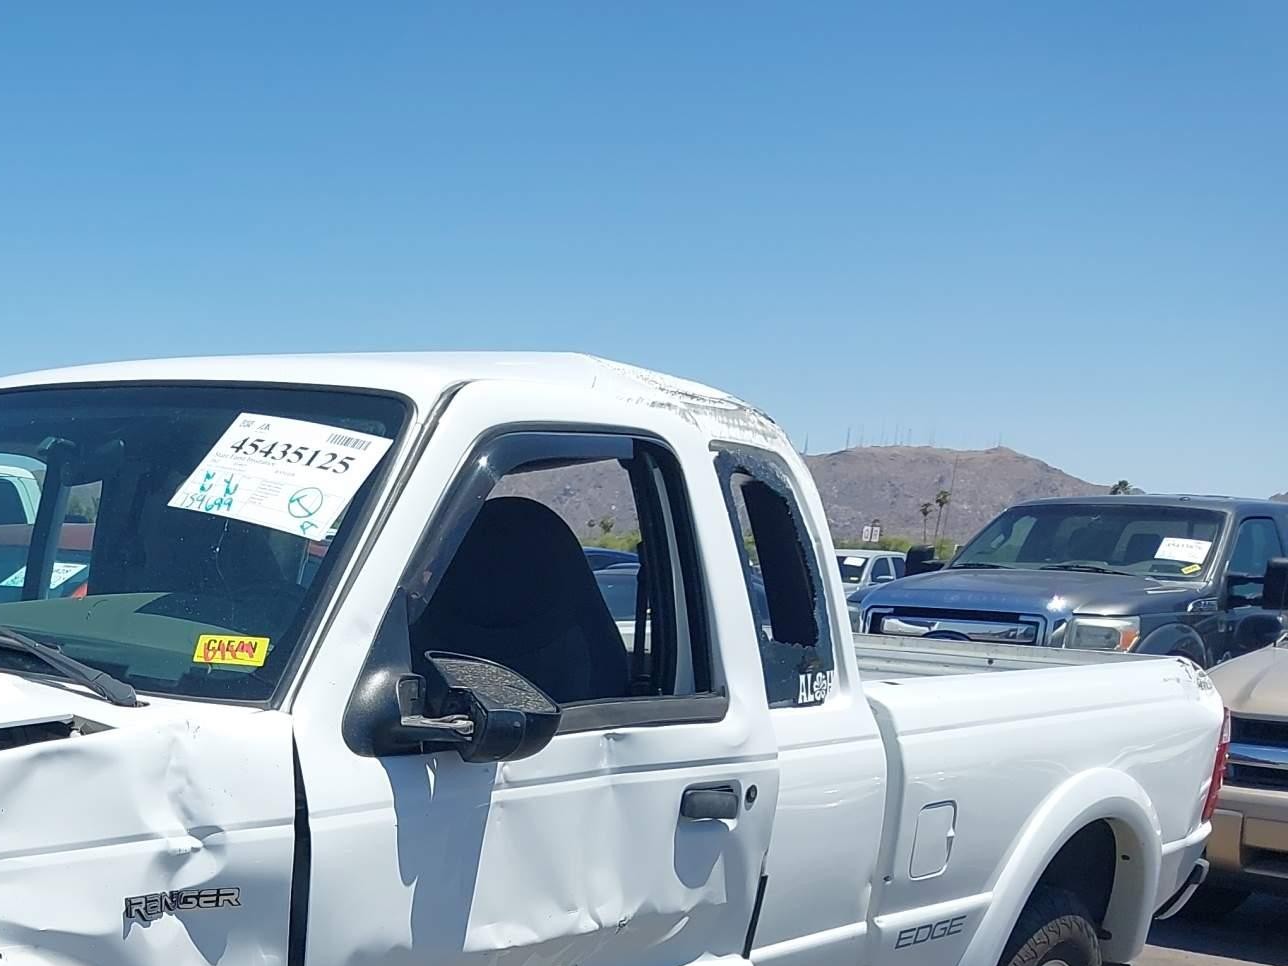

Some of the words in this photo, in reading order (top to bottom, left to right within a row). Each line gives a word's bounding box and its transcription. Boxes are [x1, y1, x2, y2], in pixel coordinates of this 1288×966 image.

[229, 436, 356, 475] 45435125
[125, 887, 241, 921] RANGER
[894, 915, 967, 950] EDGE
